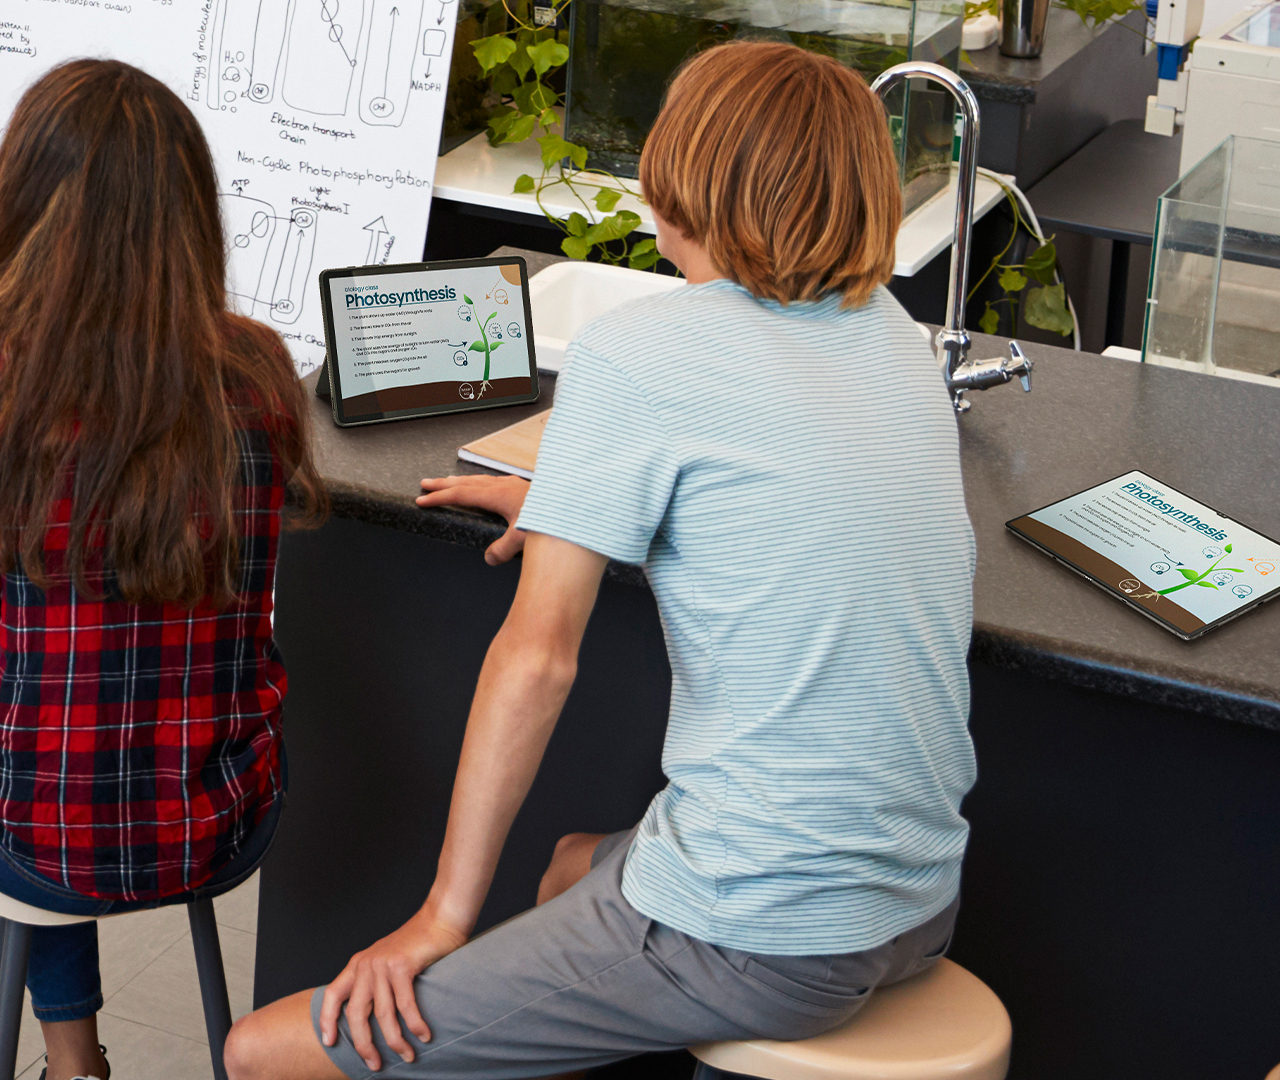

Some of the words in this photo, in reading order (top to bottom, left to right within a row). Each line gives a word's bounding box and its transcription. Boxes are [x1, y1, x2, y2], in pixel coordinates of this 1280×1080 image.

[192, 51, 207, 63] of
[186, 66, 207, 102] Energy
[411, 80, 441, 92] NADPH
[271, 113, 310, 131] Electron
[313, 122, 356, 140] transport
[279, 130, 306, 145] Chain
[232, 179, 250, 187] ATP
[299, 161, 430, 189] Photophosphorylation
[345, 286, 456, 307] Photosynthesis
[1123, 482, 1228, 541] Photosynthesis
